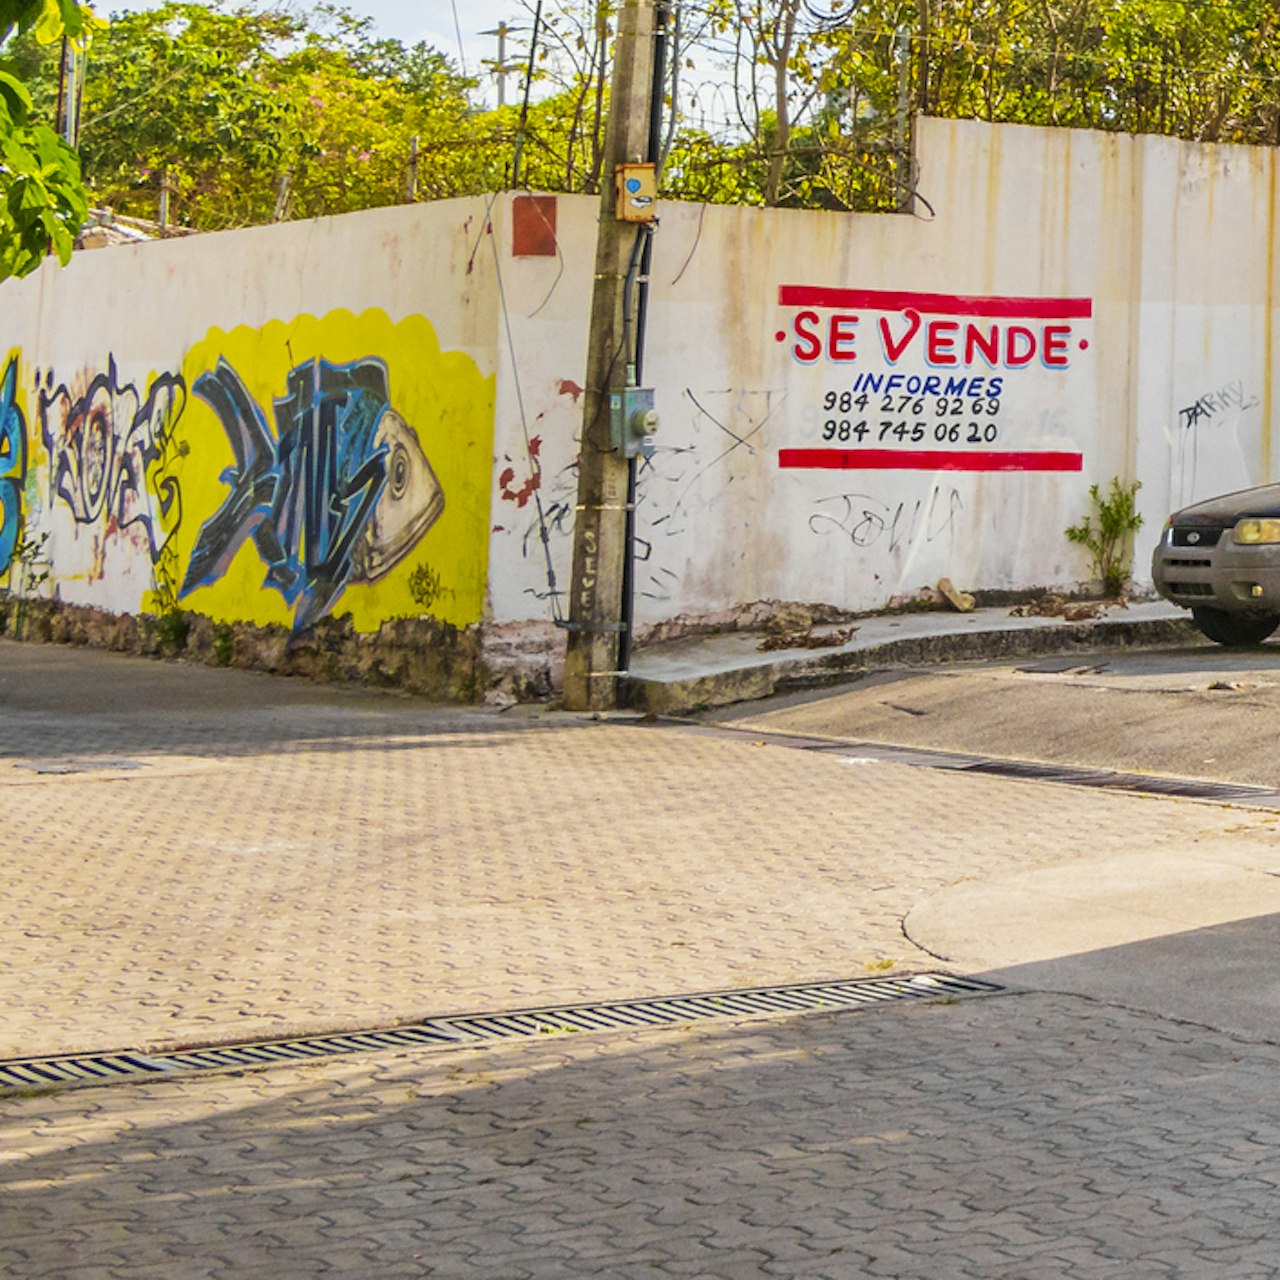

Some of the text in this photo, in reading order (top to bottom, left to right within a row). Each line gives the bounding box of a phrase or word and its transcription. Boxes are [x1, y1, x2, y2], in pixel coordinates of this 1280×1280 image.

[792, 309, 1072, 369] SE VENDE
[853, 373, 1003, 397] INFORMES
[823, 391, 869, 413] 984
[880, 395, 924, 415] 276
[822, 420, 870, 443] 984
[878, 421, 926, 442] 745
